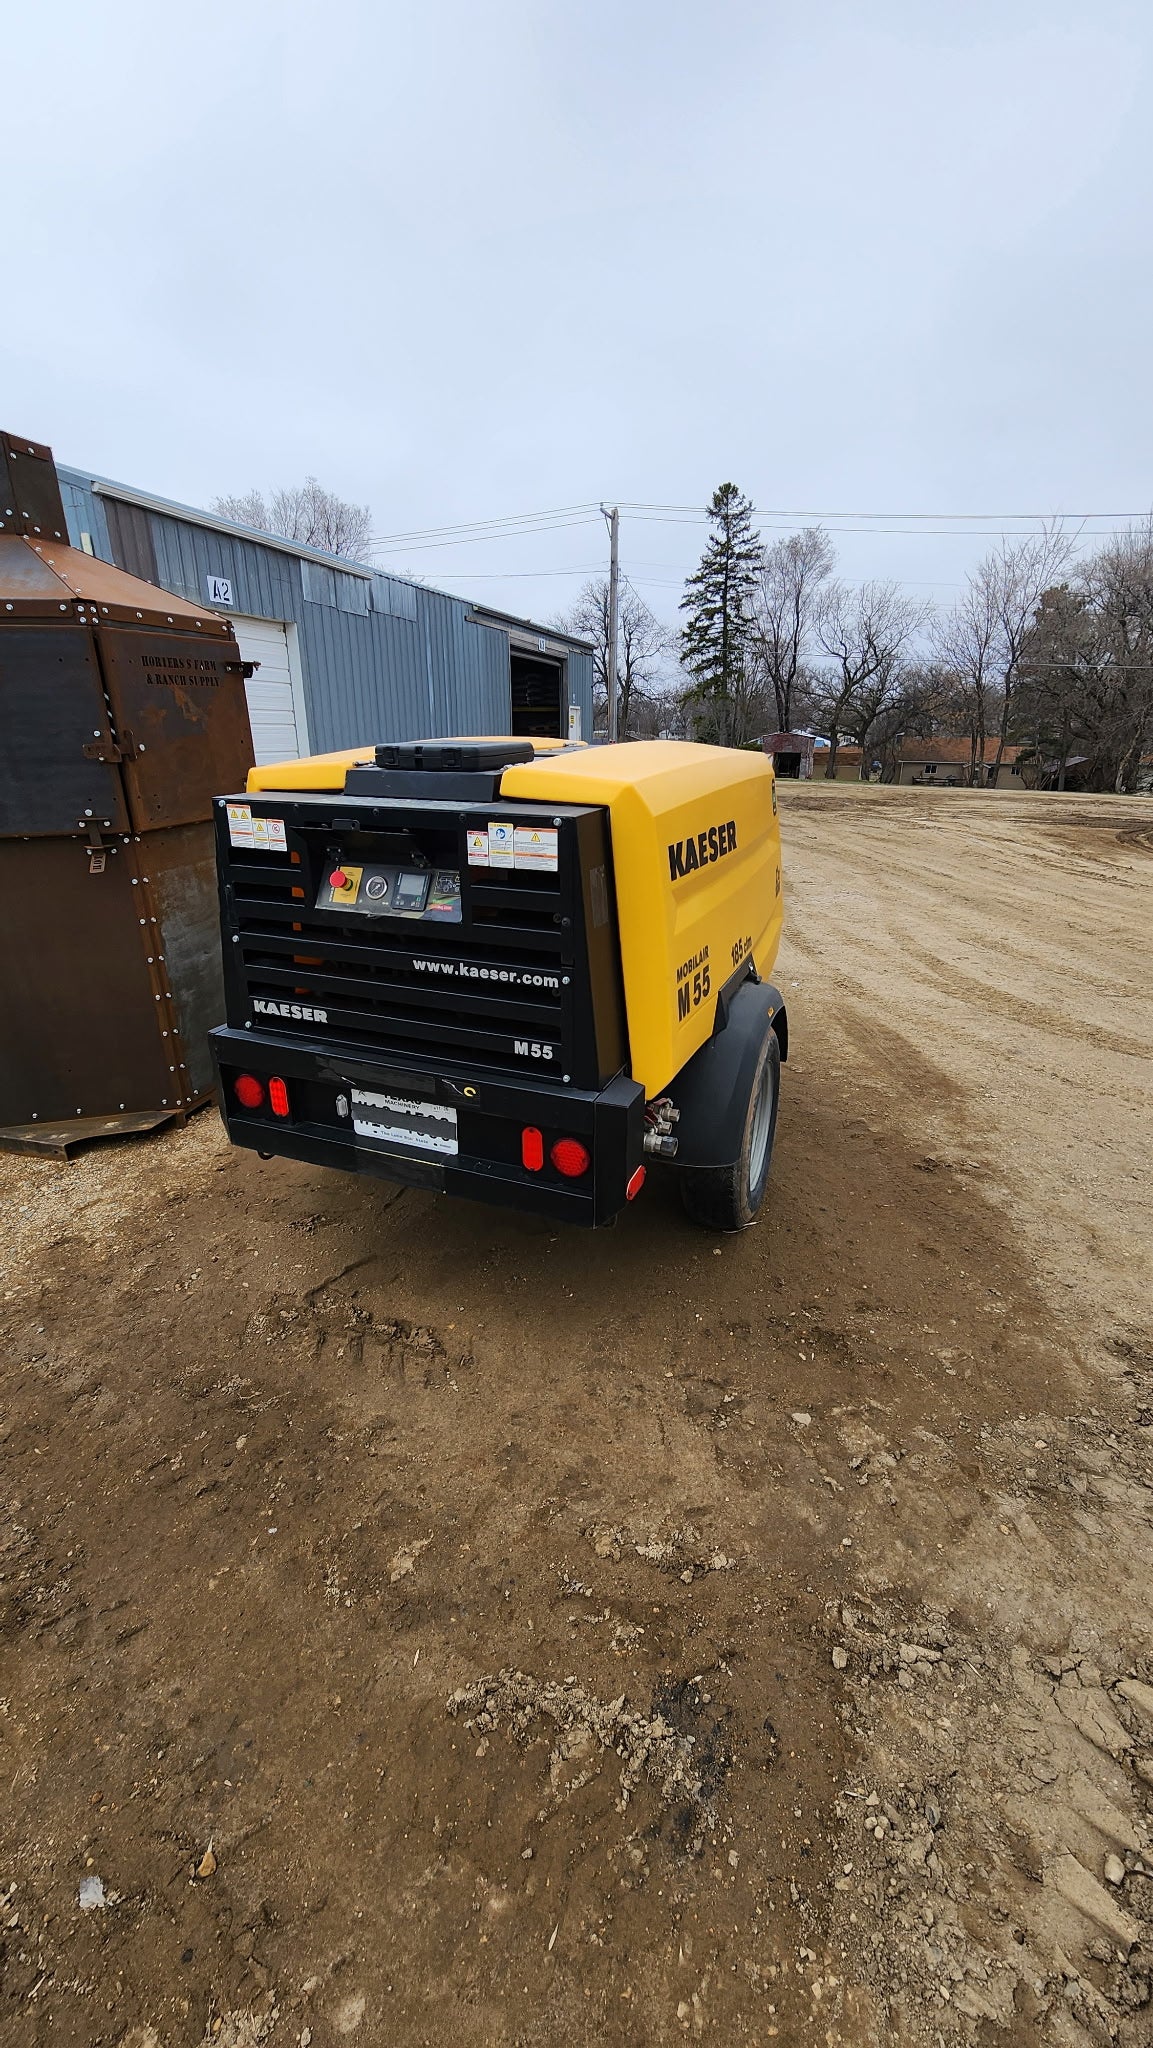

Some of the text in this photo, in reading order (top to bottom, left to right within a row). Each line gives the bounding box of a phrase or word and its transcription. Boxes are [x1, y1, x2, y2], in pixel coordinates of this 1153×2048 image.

[213, 579, 230, 601] A2
[193, 659, 217, 671] FARM
[146, 673, 220, 687] & RANCH SUPPLY
[668, 820, 737, 881] KAESER
[676, 944, 710, 984] MOBILAIR
[731, 937, 744, 967] 185
[412, 958, 560, 988] www.kaeser.com
[677, 963, 711, 1022] M 55
[253, 999, 329, 1024] KAESER
[513, 1040, 554, 1060] M 55
[384, 1099, 421, 1111] MACHINERY
